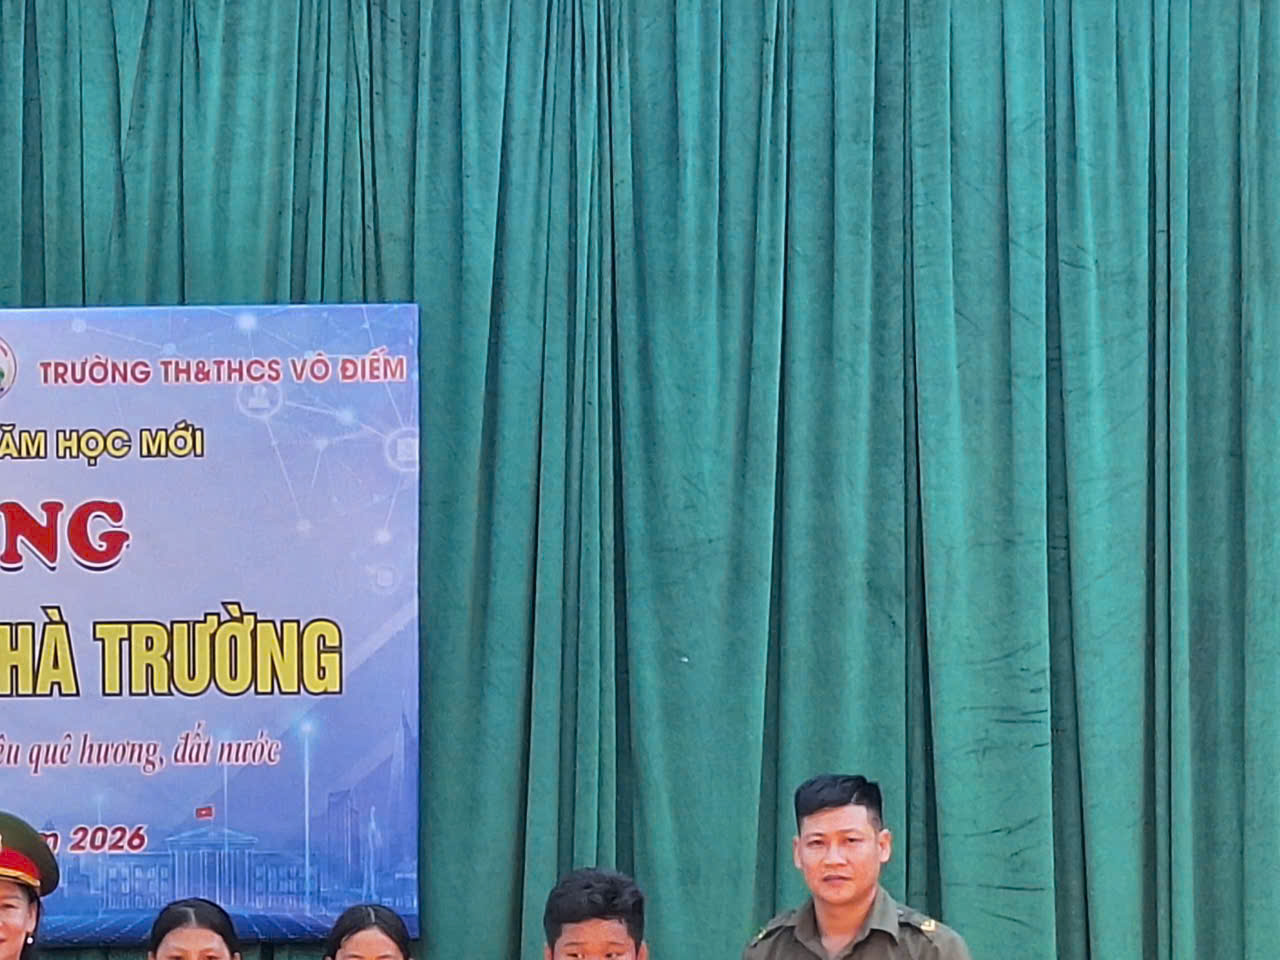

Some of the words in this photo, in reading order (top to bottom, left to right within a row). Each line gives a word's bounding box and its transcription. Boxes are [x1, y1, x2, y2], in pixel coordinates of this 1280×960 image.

[39, 355, 152, 384] TRƯỜNG
[159, 359, 282, 383] TH&THCS
[289, 351, 331, 382] VÔ
[339, 346, 406, 382] ĐIẾM
[57, 430, 131, 467] HỌC
[139, 422, 204, 457] MỚI
[93, 602, 343, 697] TRƯỜNG
[26, 733, 73, 774] quê
[78, 732, 167, 774] hương,
[172, 720, 213, 766] đất
[217, 729, 281, 765] nước
[68, 824, 147, 853] 2026
